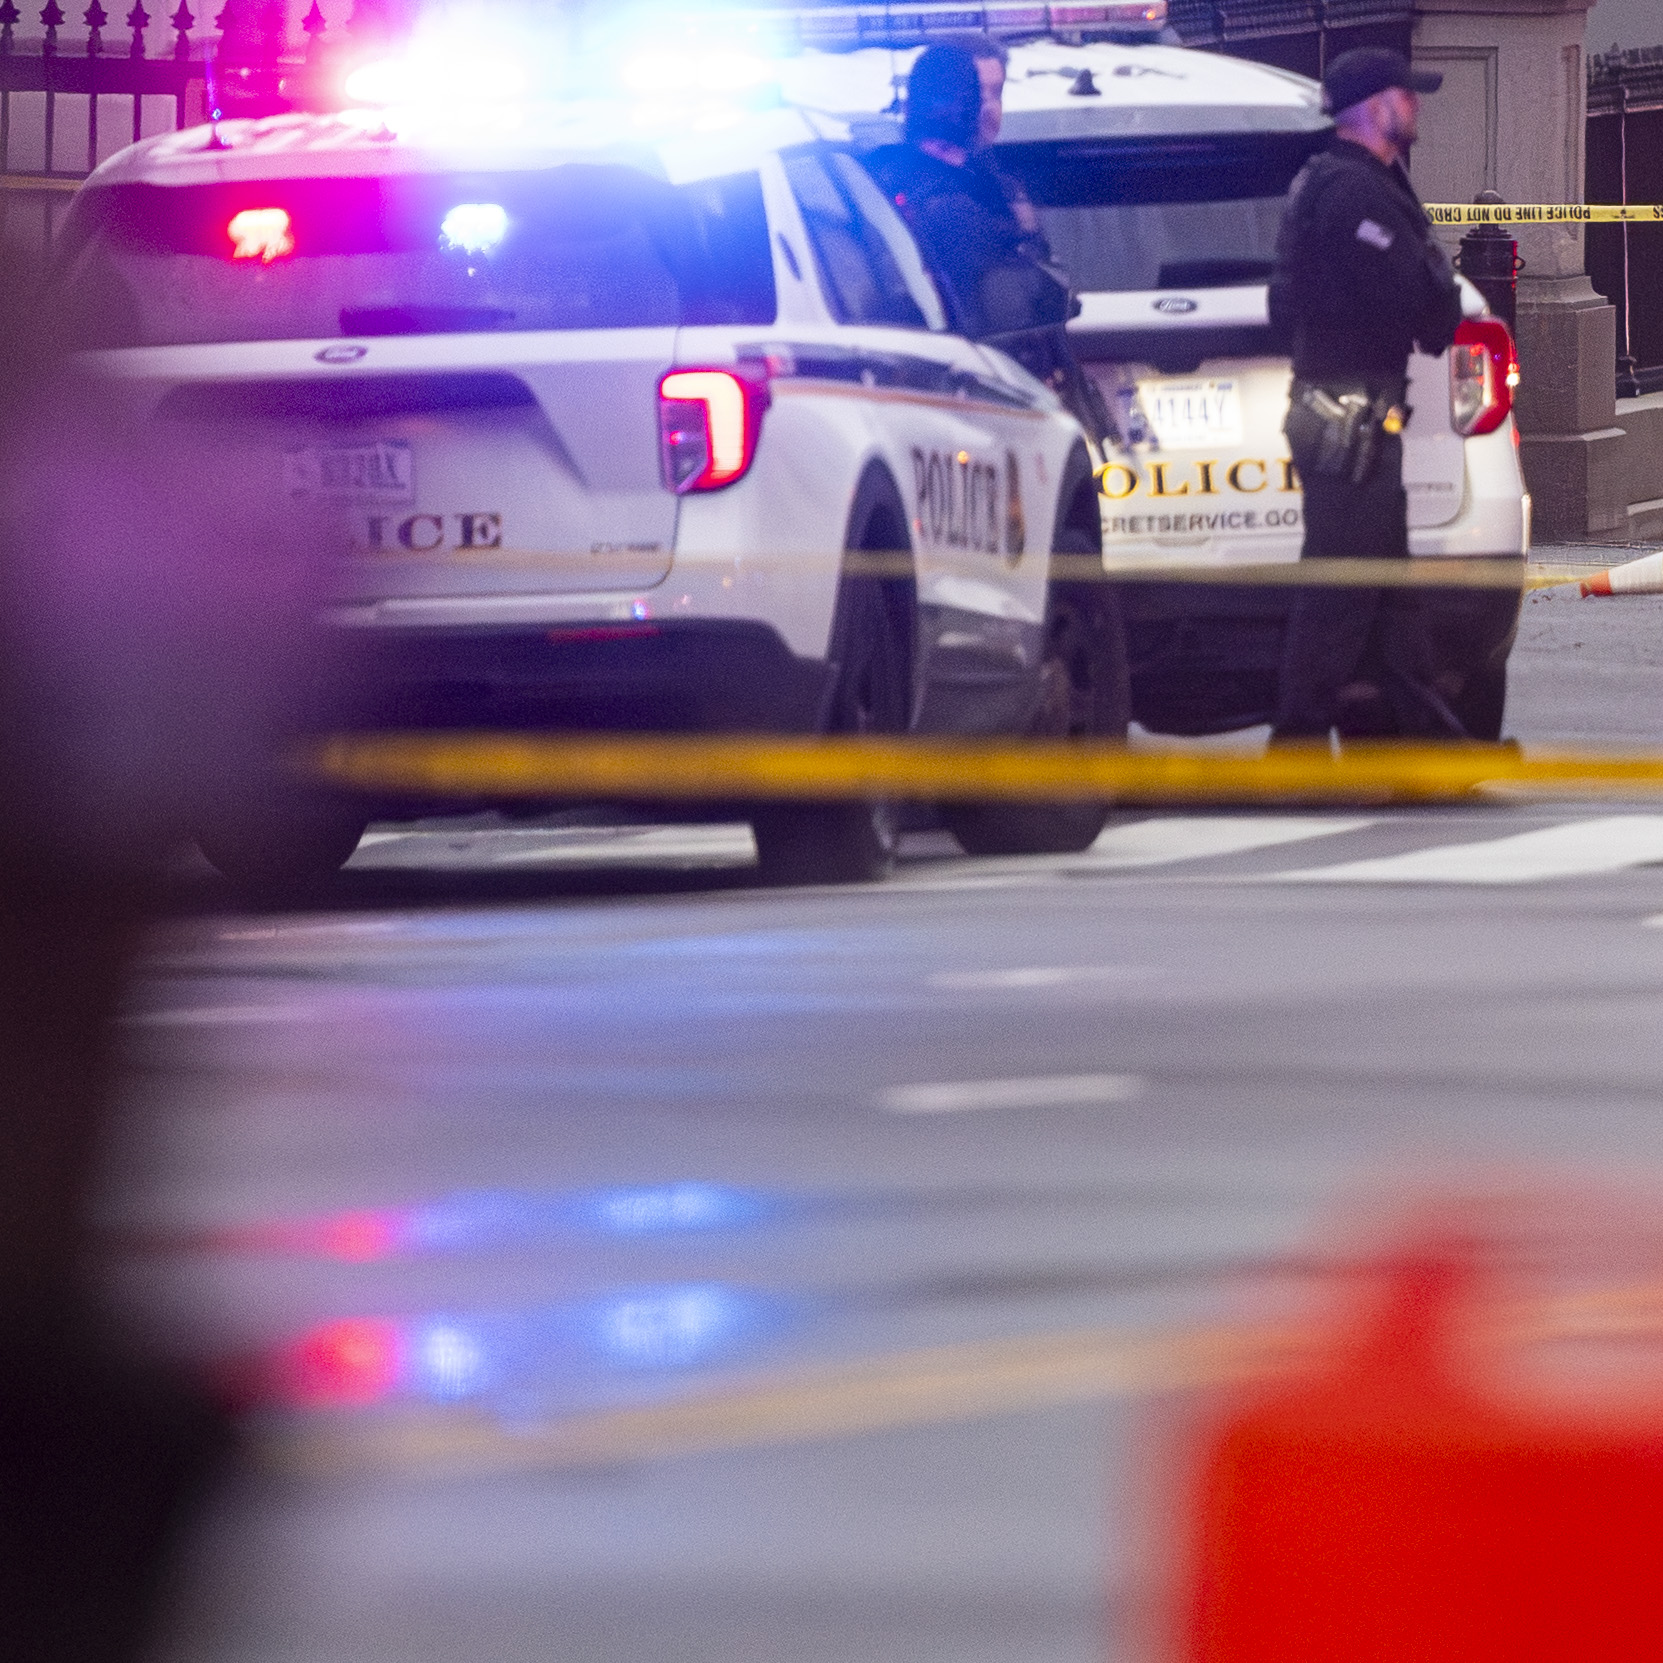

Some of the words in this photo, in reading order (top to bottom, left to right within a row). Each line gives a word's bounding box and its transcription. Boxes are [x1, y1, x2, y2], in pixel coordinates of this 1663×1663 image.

[1427, 207, 1463, 224] CROS
[1467, 208, 1490, 223] NOT
[1493, 207, 1511, 222] DO
[1515, 206, 1542, 221] LINE
[1547, 205, 1591, 221] POLICE
[1093, 457, 1304, 499] OLIC
[910, 442, 999, 555] POLICE
[355, 512, 503, 553] ICE
